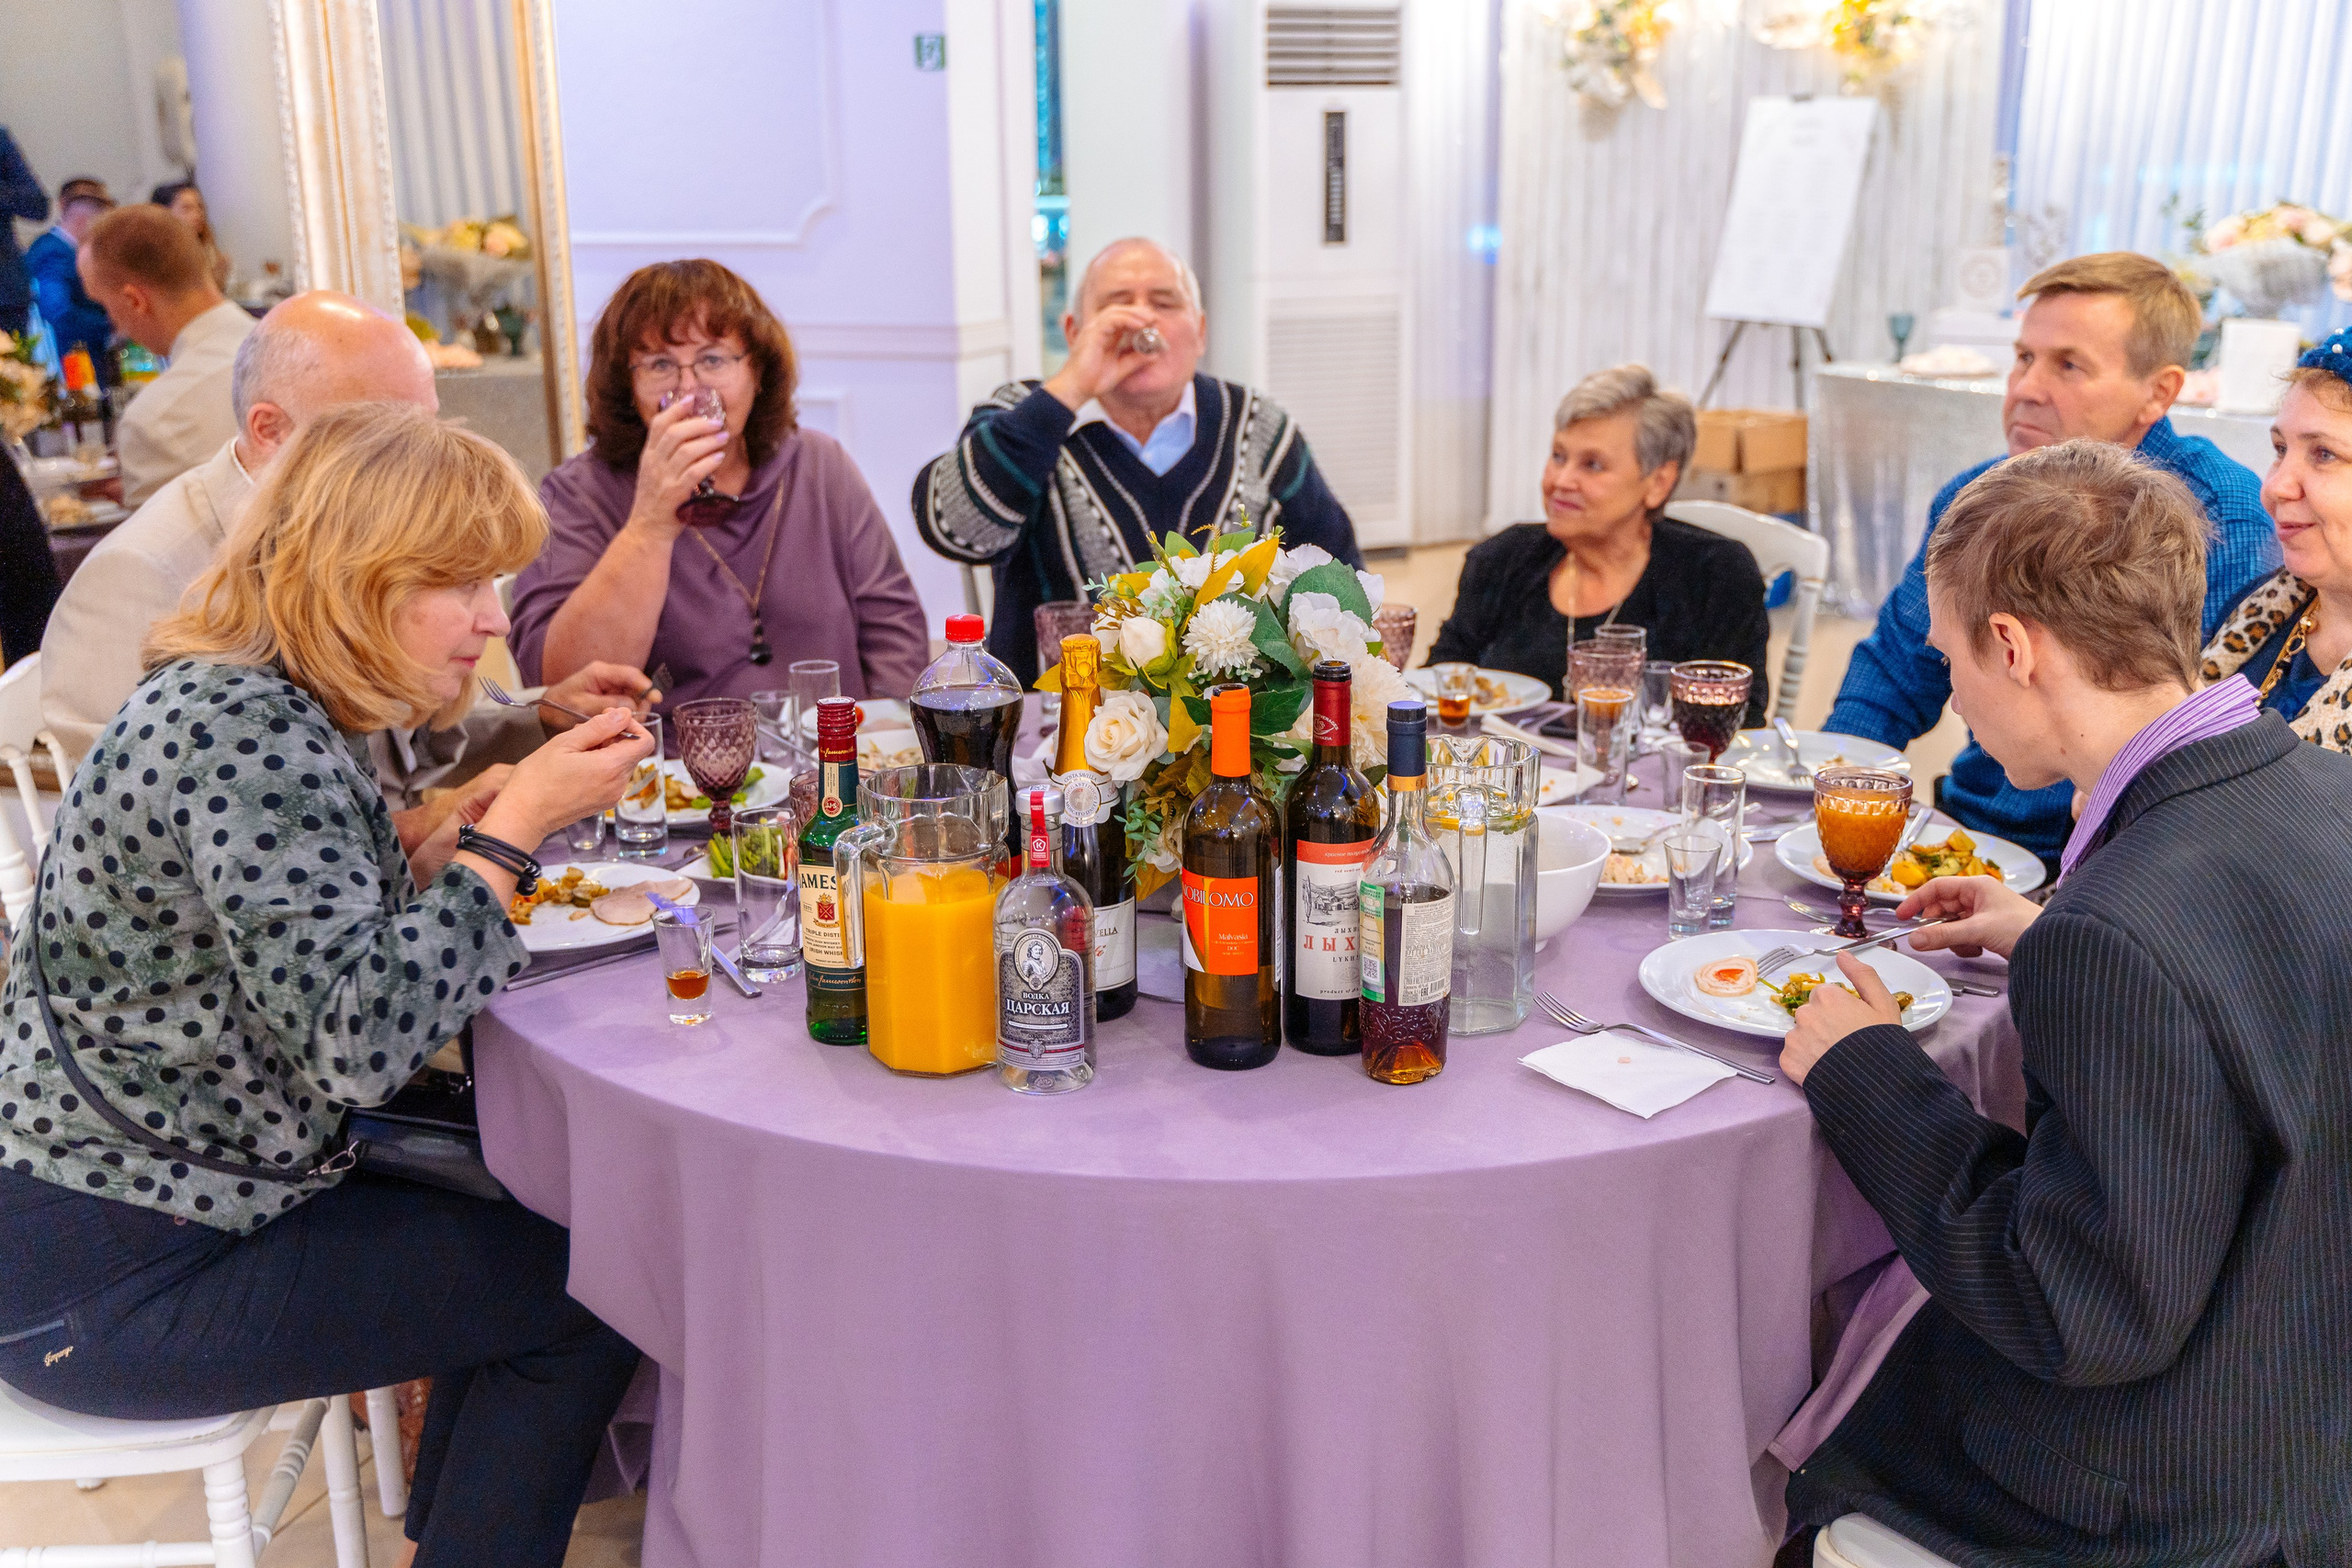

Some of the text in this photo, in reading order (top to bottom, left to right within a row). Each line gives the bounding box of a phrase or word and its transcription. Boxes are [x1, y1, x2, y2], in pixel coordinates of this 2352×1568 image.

[1064, 773, 1078, 783] COSTA
[799, 874, 836, 890] AMES
[805, 928, 821, 936] TRIPLE
[1096, 927, 1118, 937] VELLA
[1304, 935, 1356, 952] ЛЫХ
[1023, 992, 1049, 1000] ВОДКА
[1006, 998, 1070, 1016] ЦАРСКАЯ
